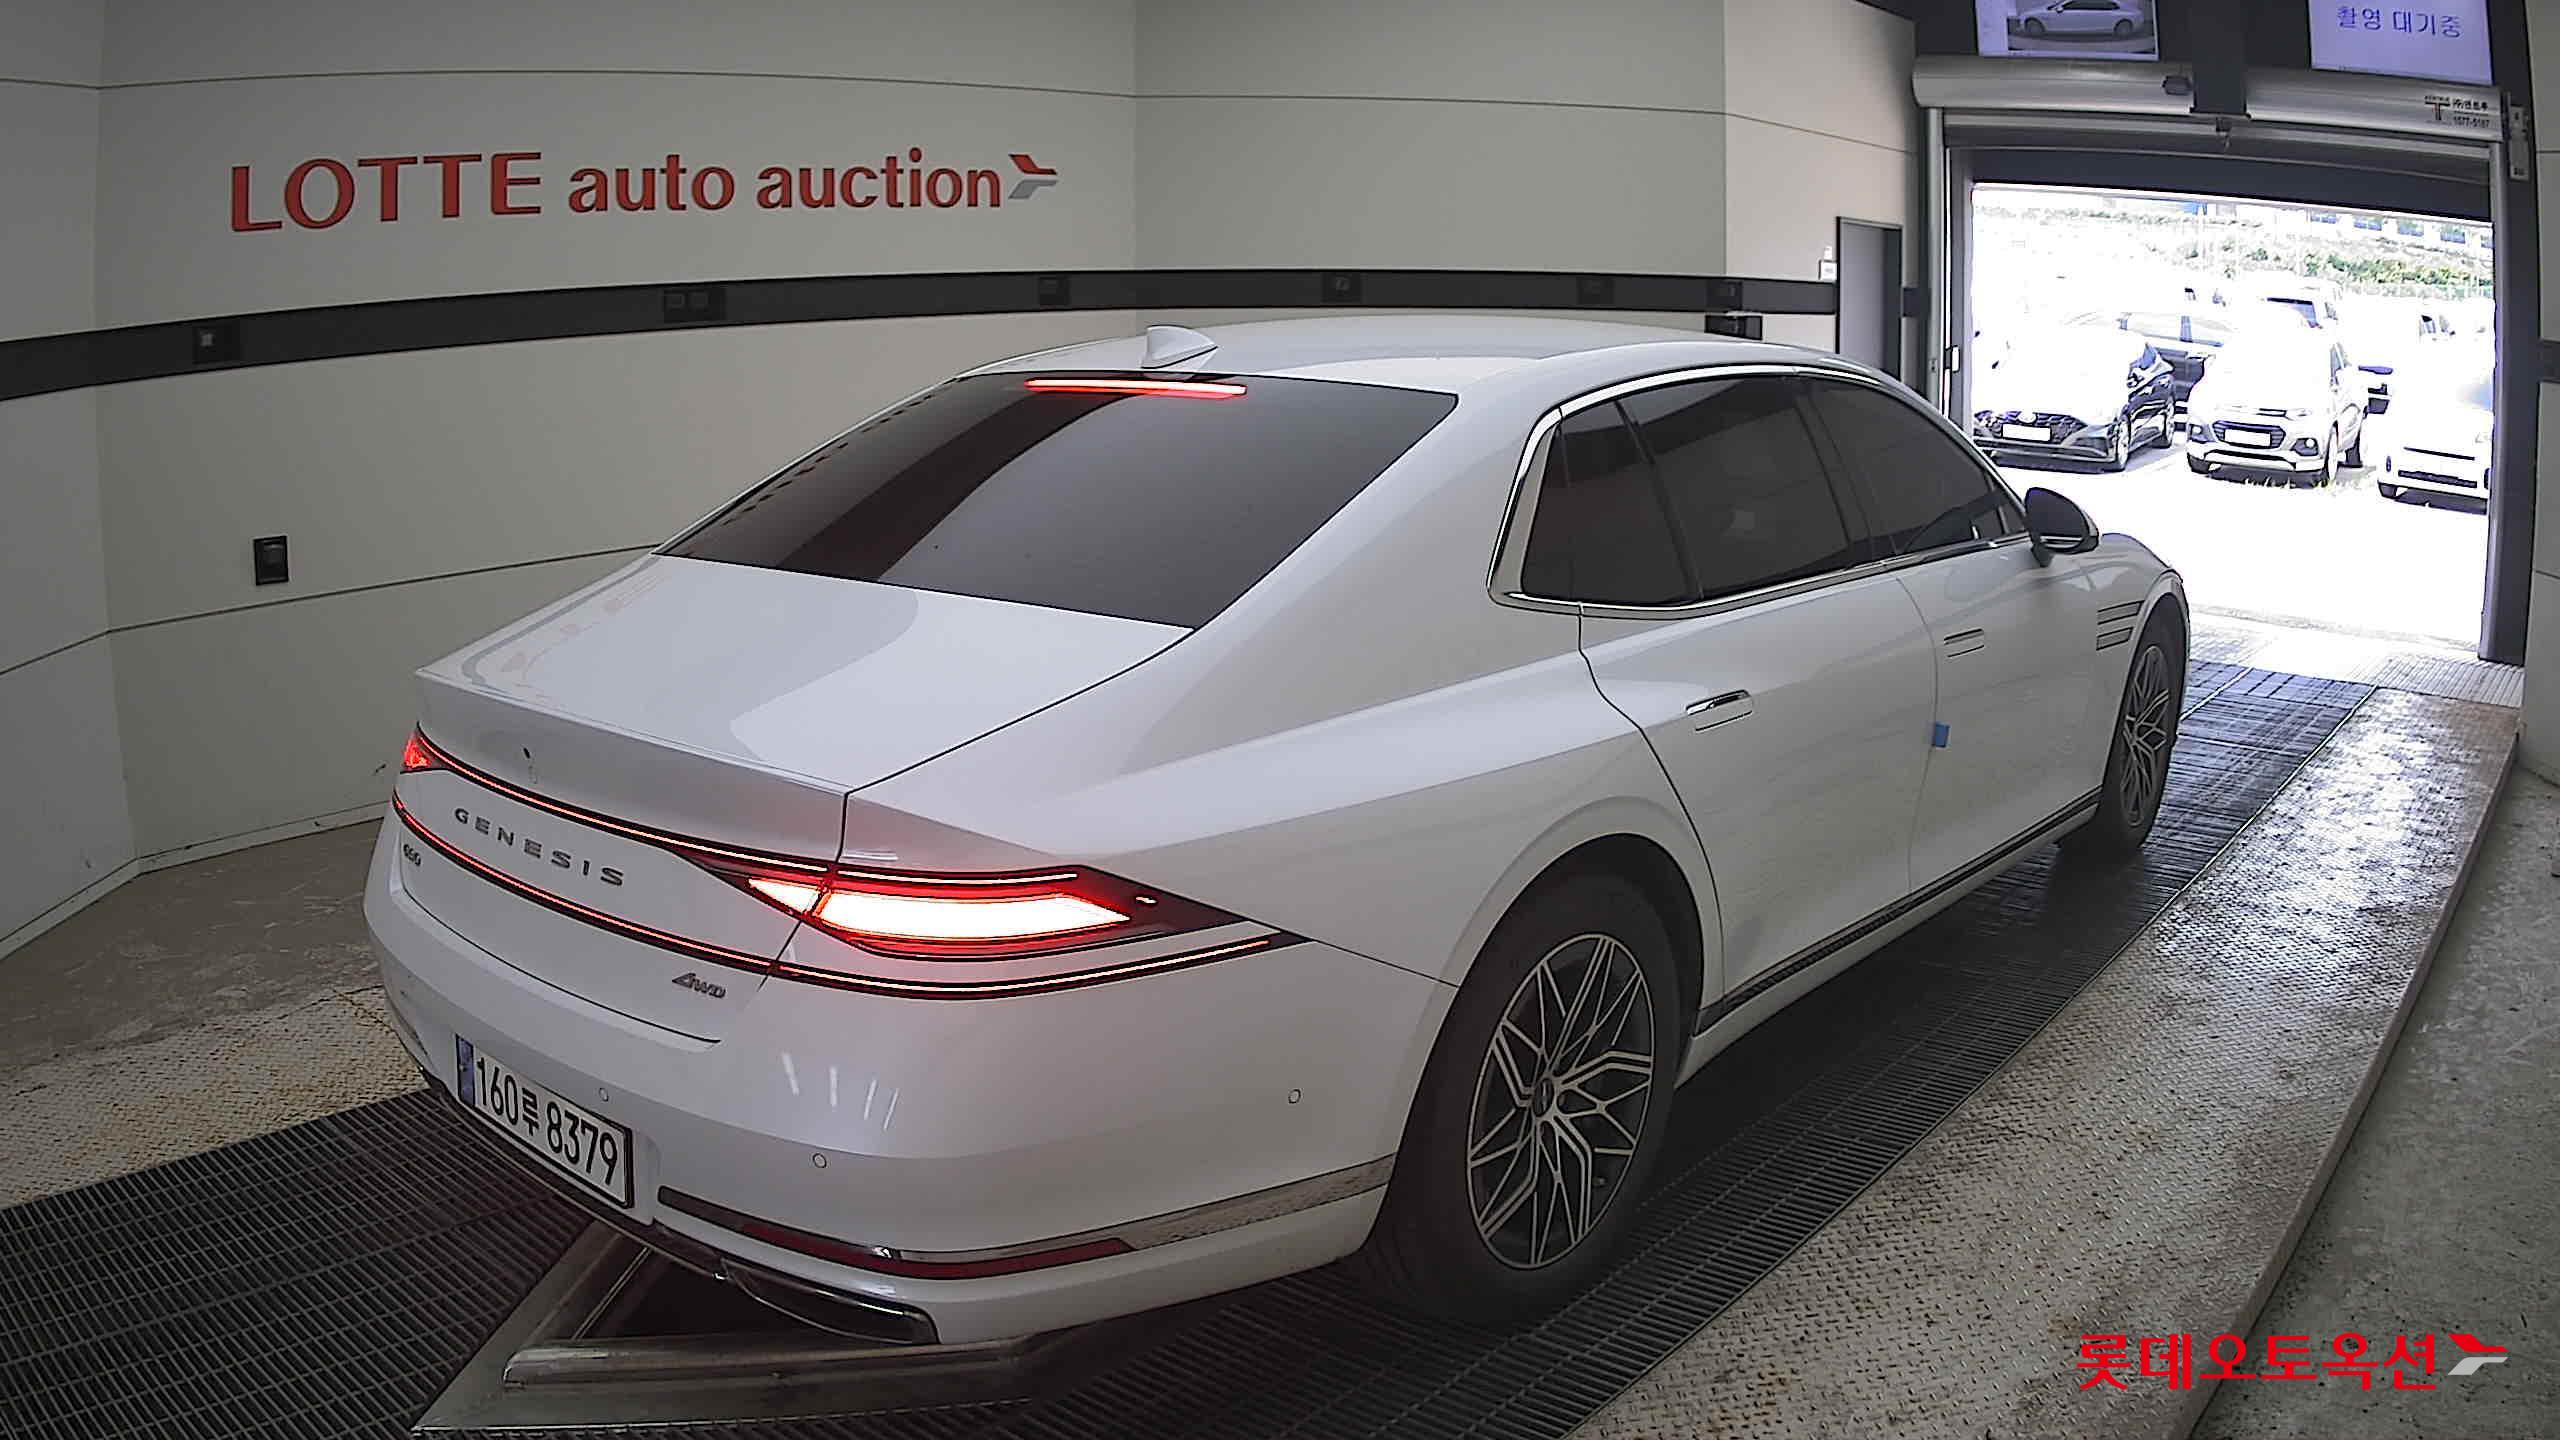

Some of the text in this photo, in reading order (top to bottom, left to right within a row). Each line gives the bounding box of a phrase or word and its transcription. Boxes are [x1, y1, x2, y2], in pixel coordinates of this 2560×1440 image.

[2338, 6, 2461, 38] 촬영 대기중
[231, 147, 1001, 232] LOTTE auto auction
[454, 807, 624, 886] GENESIS
[671, 972, 726, 998] 4WD
[476, 1056, 618, 1186] 160루 8379
